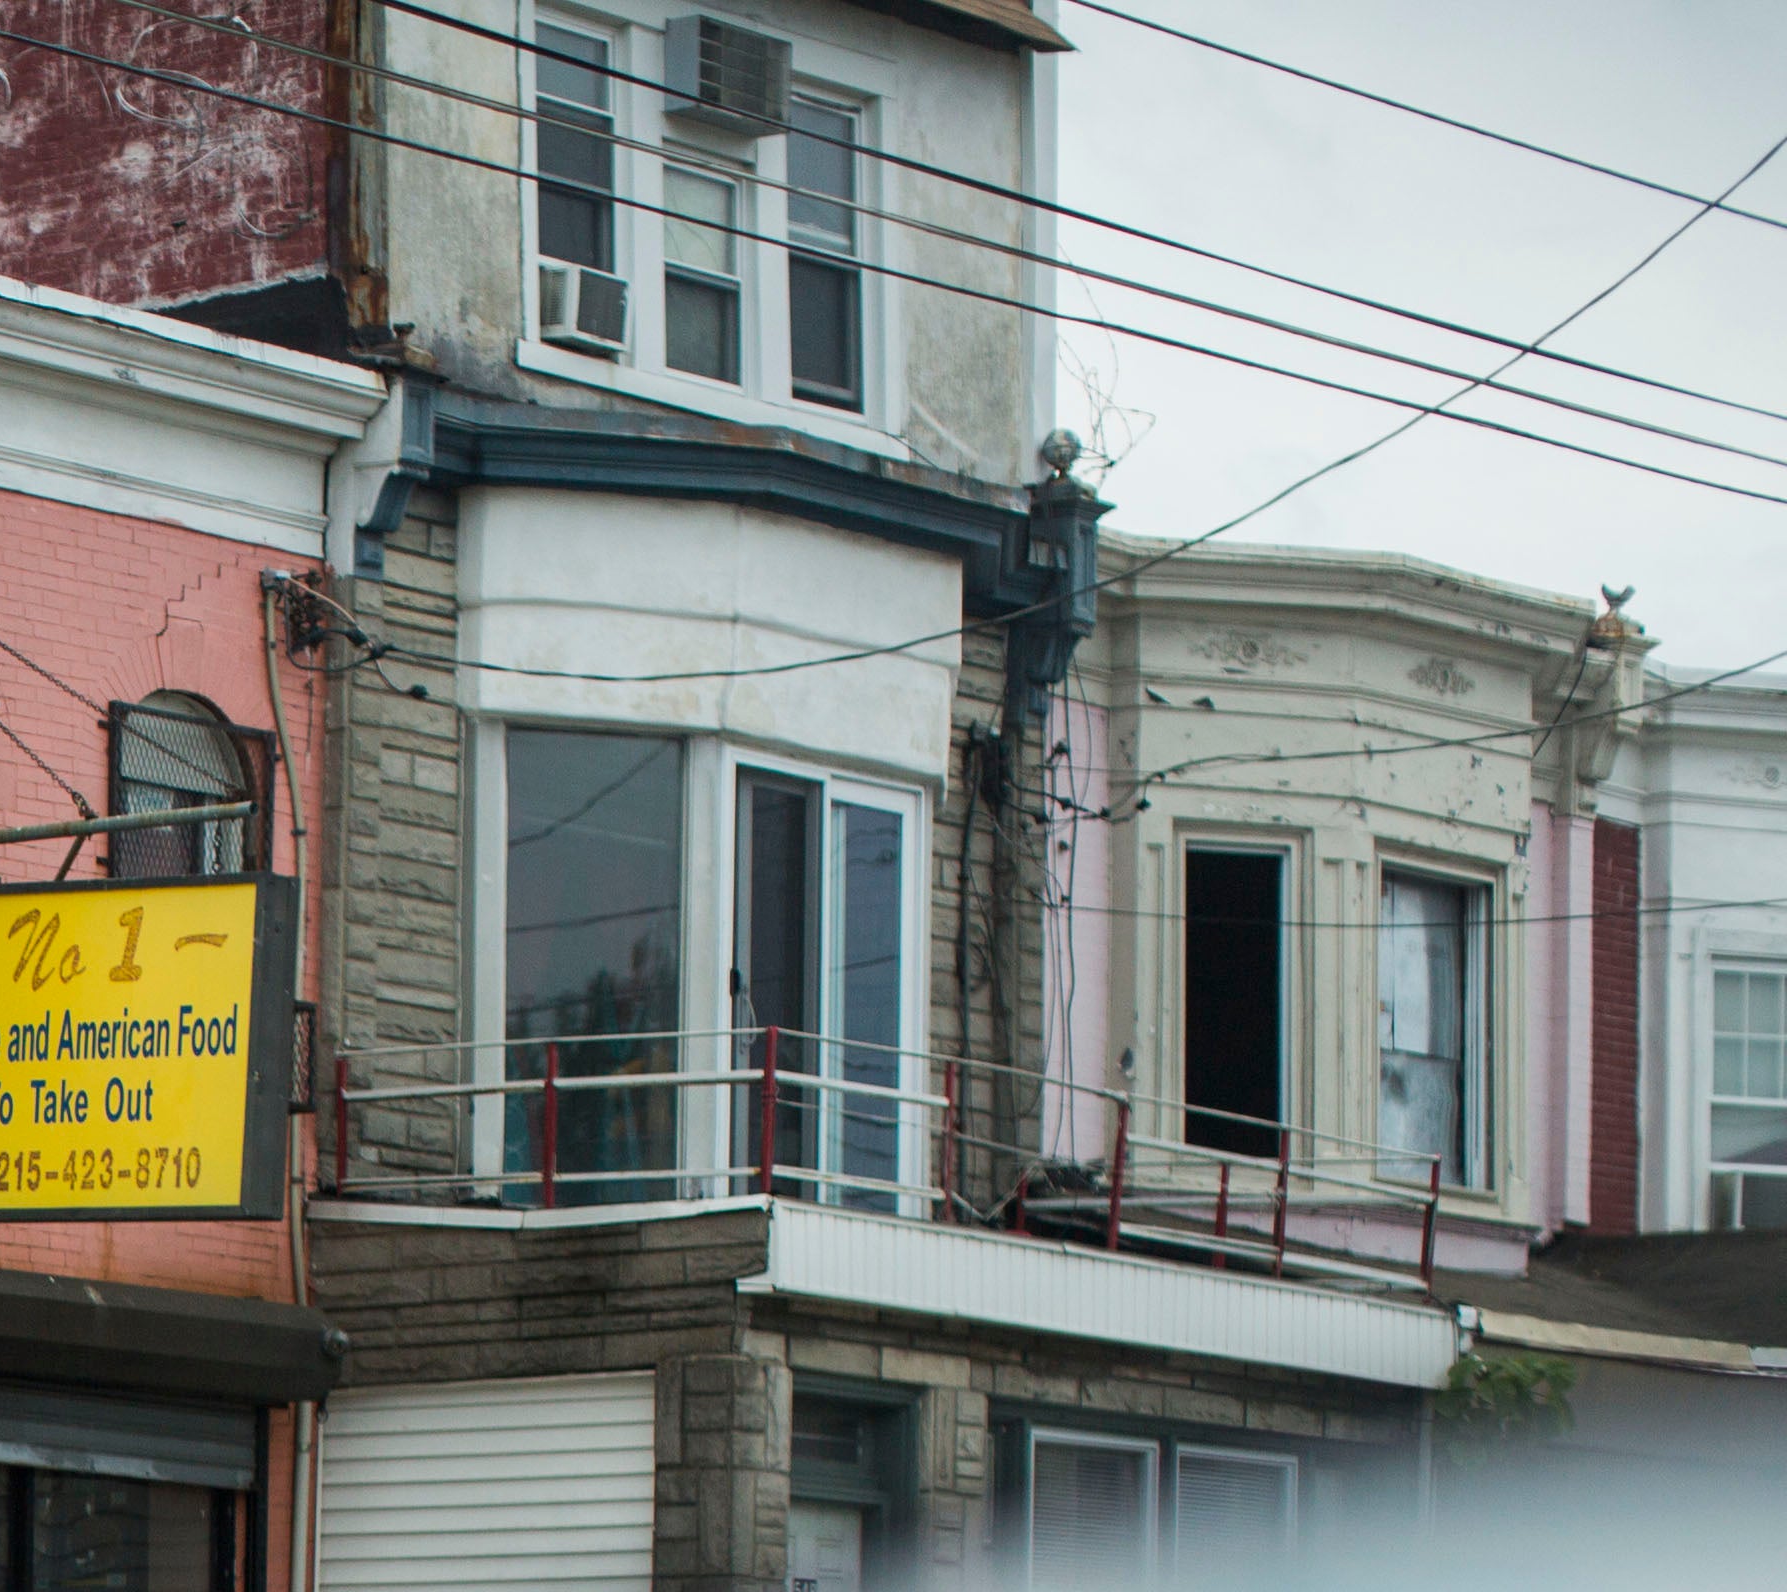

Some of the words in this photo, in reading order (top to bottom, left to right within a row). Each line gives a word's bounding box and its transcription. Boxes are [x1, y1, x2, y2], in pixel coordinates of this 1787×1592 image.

[8, 907, 87, 991] No
[109, 906, 144, 982] 1
[7, 1009, 51, 1062] and
[57, 1008, 170, 1061] American
[177, 1003, 238, 1057] Food
[31, 1079, 88, 1124] Take
[104, 1077, 154, 1122] Out
